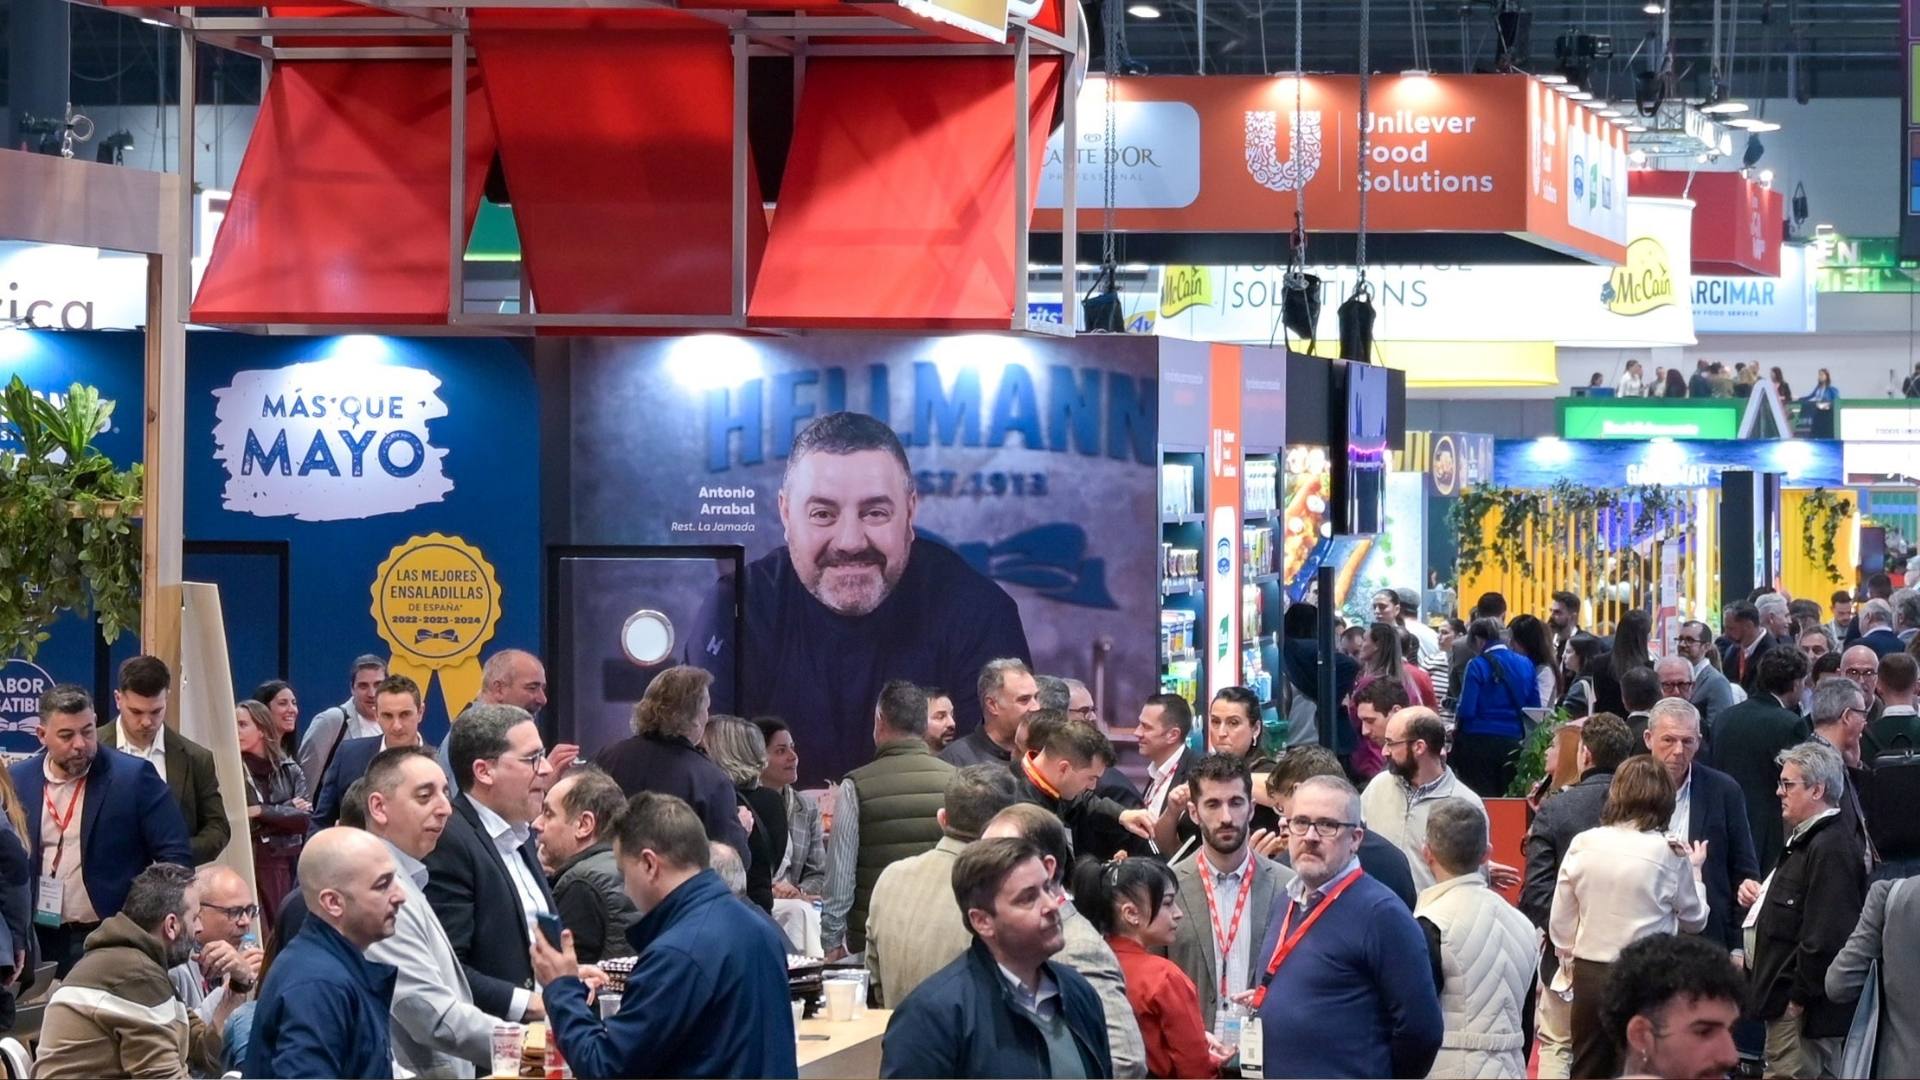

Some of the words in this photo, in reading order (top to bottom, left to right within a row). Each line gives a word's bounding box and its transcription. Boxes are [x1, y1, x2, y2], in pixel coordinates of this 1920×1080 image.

[1357, 110, 1475, 133] Unilever
[1357, 169, 1493, 192] Solutions
[1232, 280, 1428, 307] SOLTIONS
[1616, 265, 1671, 304] McCain
[262, 388, 327, 418] MÁS
[340, 396, 403, 429] QUE
[241, 428, 425, 478] MAYO
[699, 486, 755, 498] Antonio
[701, 502, 755, 515] Arrabal
[671, 522, 696, 532] Rest.
[698, 522, 711, 532] La
[712, 522, 755, 532] Jamada
[397, 569, 418, 582] LAS
[421, 570, 477, 583] MEJORES
[391, 586, 483, 600] ENSALADILLAS
[409, 604, 420, 612] DE
